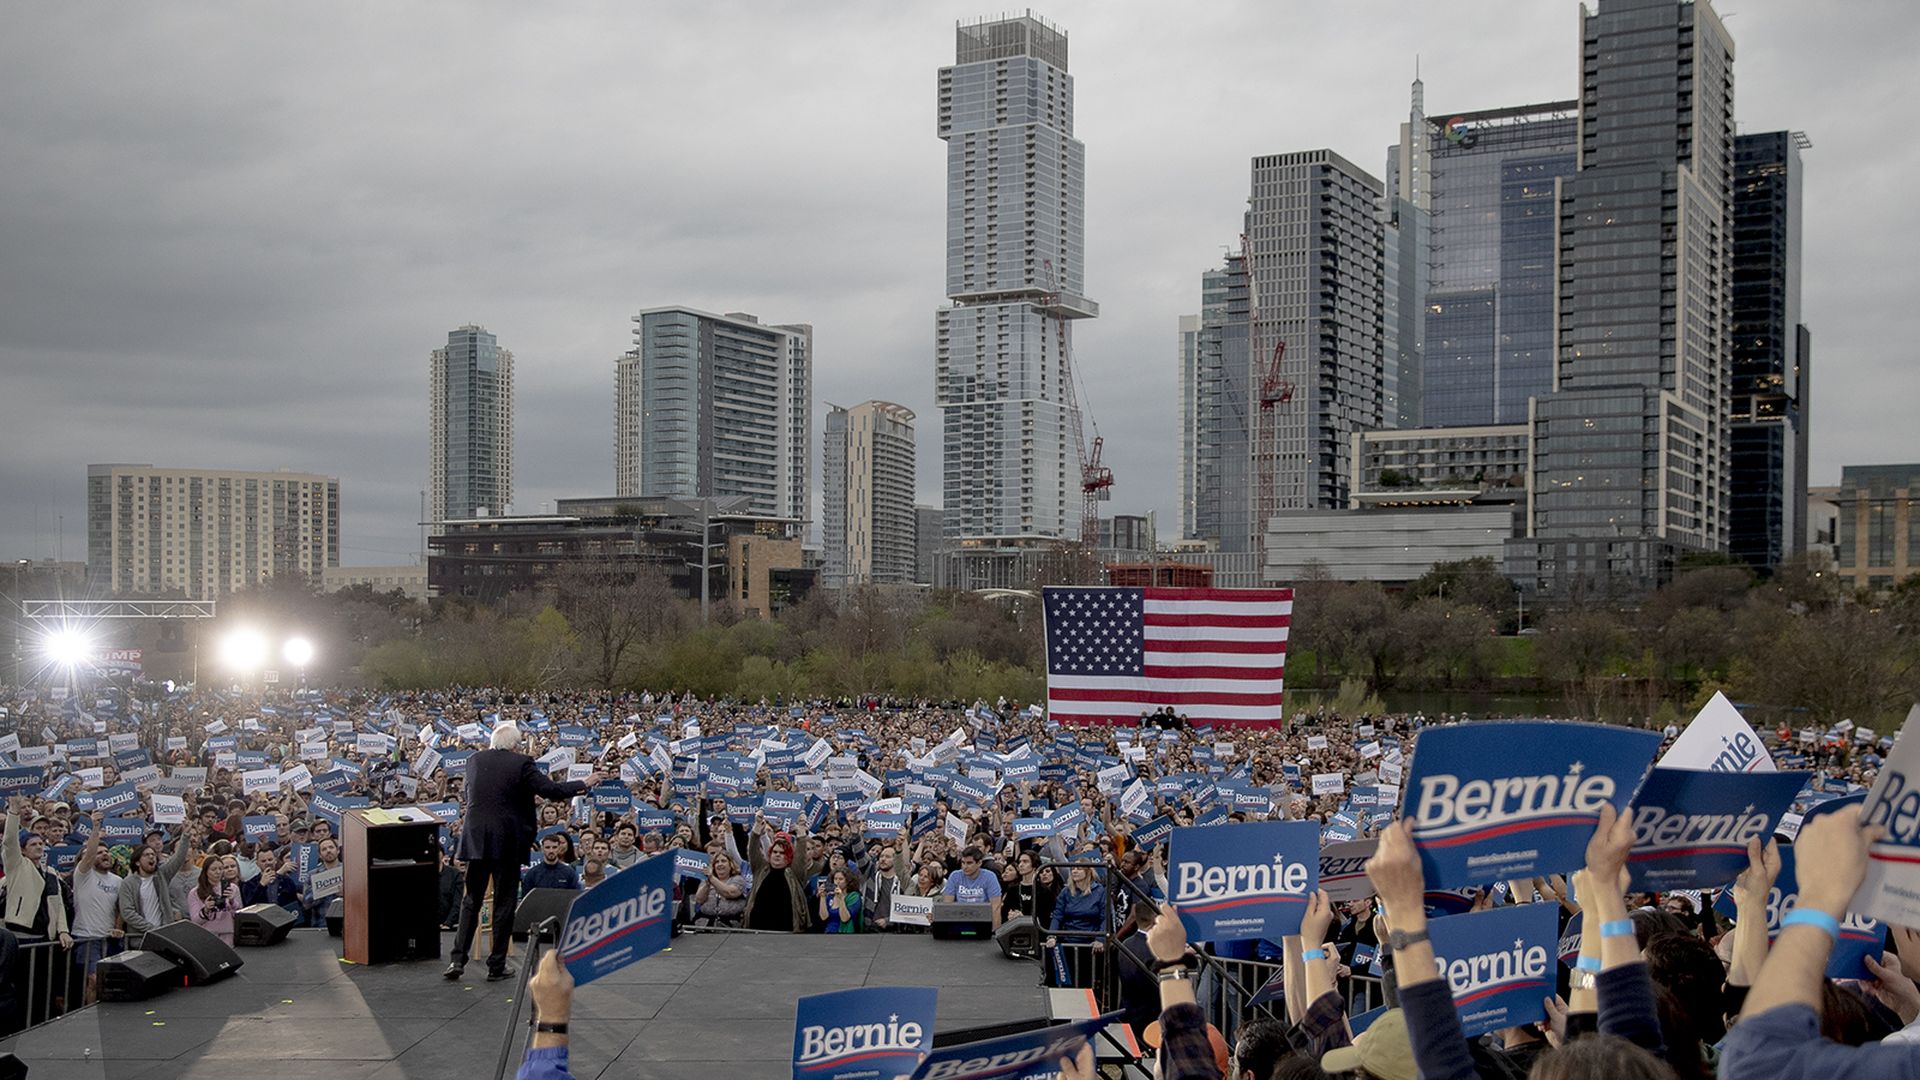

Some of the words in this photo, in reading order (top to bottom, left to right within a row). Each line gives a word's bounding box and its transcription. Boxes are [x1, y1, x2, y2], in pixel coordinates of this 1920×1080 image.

[237, 756, 264, 764] Bernie
[446, 759, 466, 767] Bern
[767, 755, 793, 764] Bernie
[1005, 764, 1036, 774] Bernie
[1, 775, 39, 786] Bernie
[83, 773, 101, 781] ernie
[245, 777, 277, 786] Bernie
[709, 772, 740, 787] Bernie
[1102, 772, 1128, 782] Bernie
[1314, 779, 1341, 788] Bernie
[953, 780, 983, 798] Bernie
[96, 790, 135, 809] Bernie
[596, 795, 629, 804] Bernie
[1236, 794, 1267, 803] Bernie
[1352, 794, 1377, 802] Bernie
[1416, 761, 1615, 828] Bernie
[766, 798, 802, 809] Bernie
[640, 817, 672, 825] Bernie
[868, 820, 901, 829] Bernie
[1632, 802, 1769, 846] Bernie
[105, 824, 142, 835] Bernie
[246, 823, 276, 833] Bernie
[1016, 823, 1051, 831] Bernie
[1137, 823, 1172, 844] Bernie
[299, 847, 310, 881] Bernie
[675, 855, 708, 869] Bernie
[1177, 853, 1308, 899] Bernie
[315, 876, 343, 889] Bern
[958, 885, 984, 895] Bernie
[894, 902, 929, 913] Bernie
[563, 884, 665, 948] Bernie
[801, 1013, 923, 1061] Bernie
